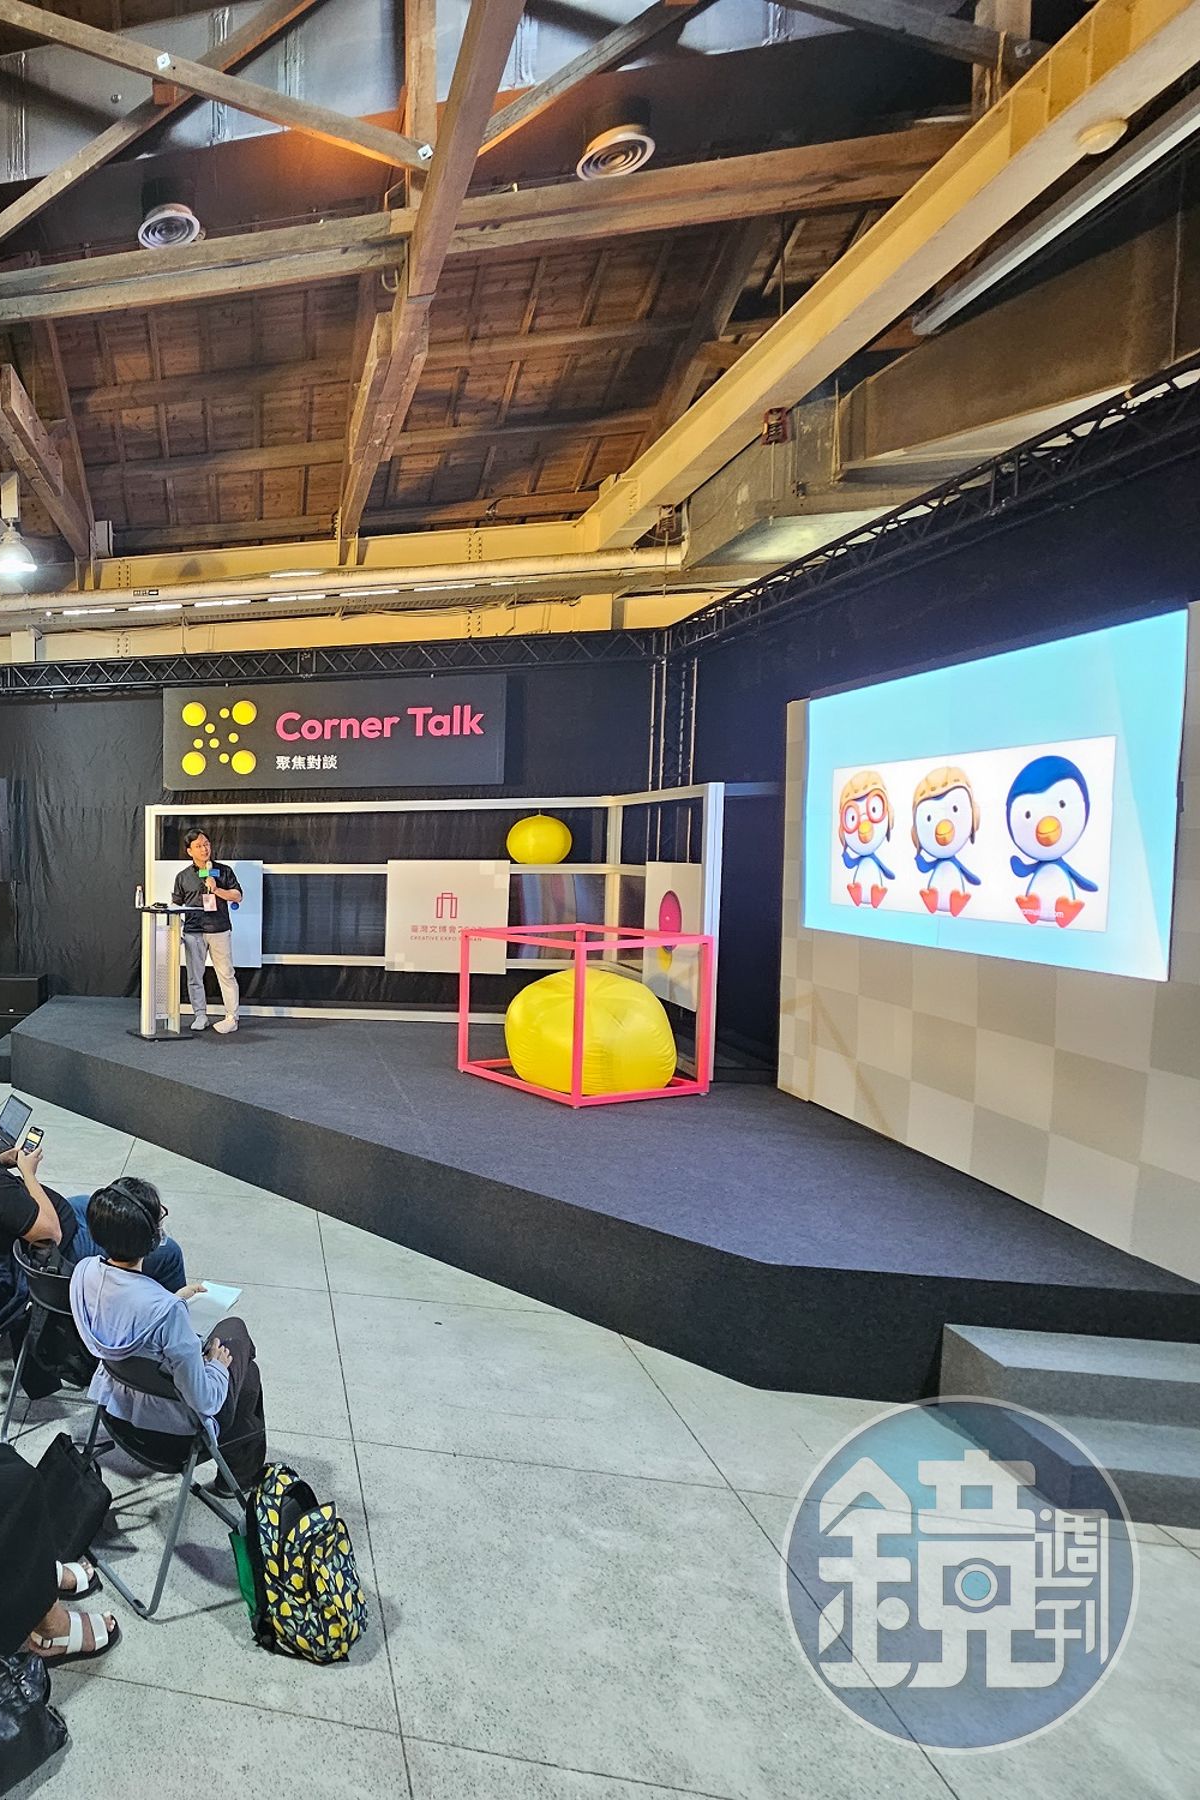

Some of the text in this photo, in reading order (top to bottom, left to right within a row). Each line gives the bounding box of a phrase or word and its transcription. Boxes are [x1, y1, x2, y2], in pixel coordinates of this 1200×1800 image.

[275, 704, 485, 741] Corner Talk
[275, 754, 338, 771] 聚焦對談
